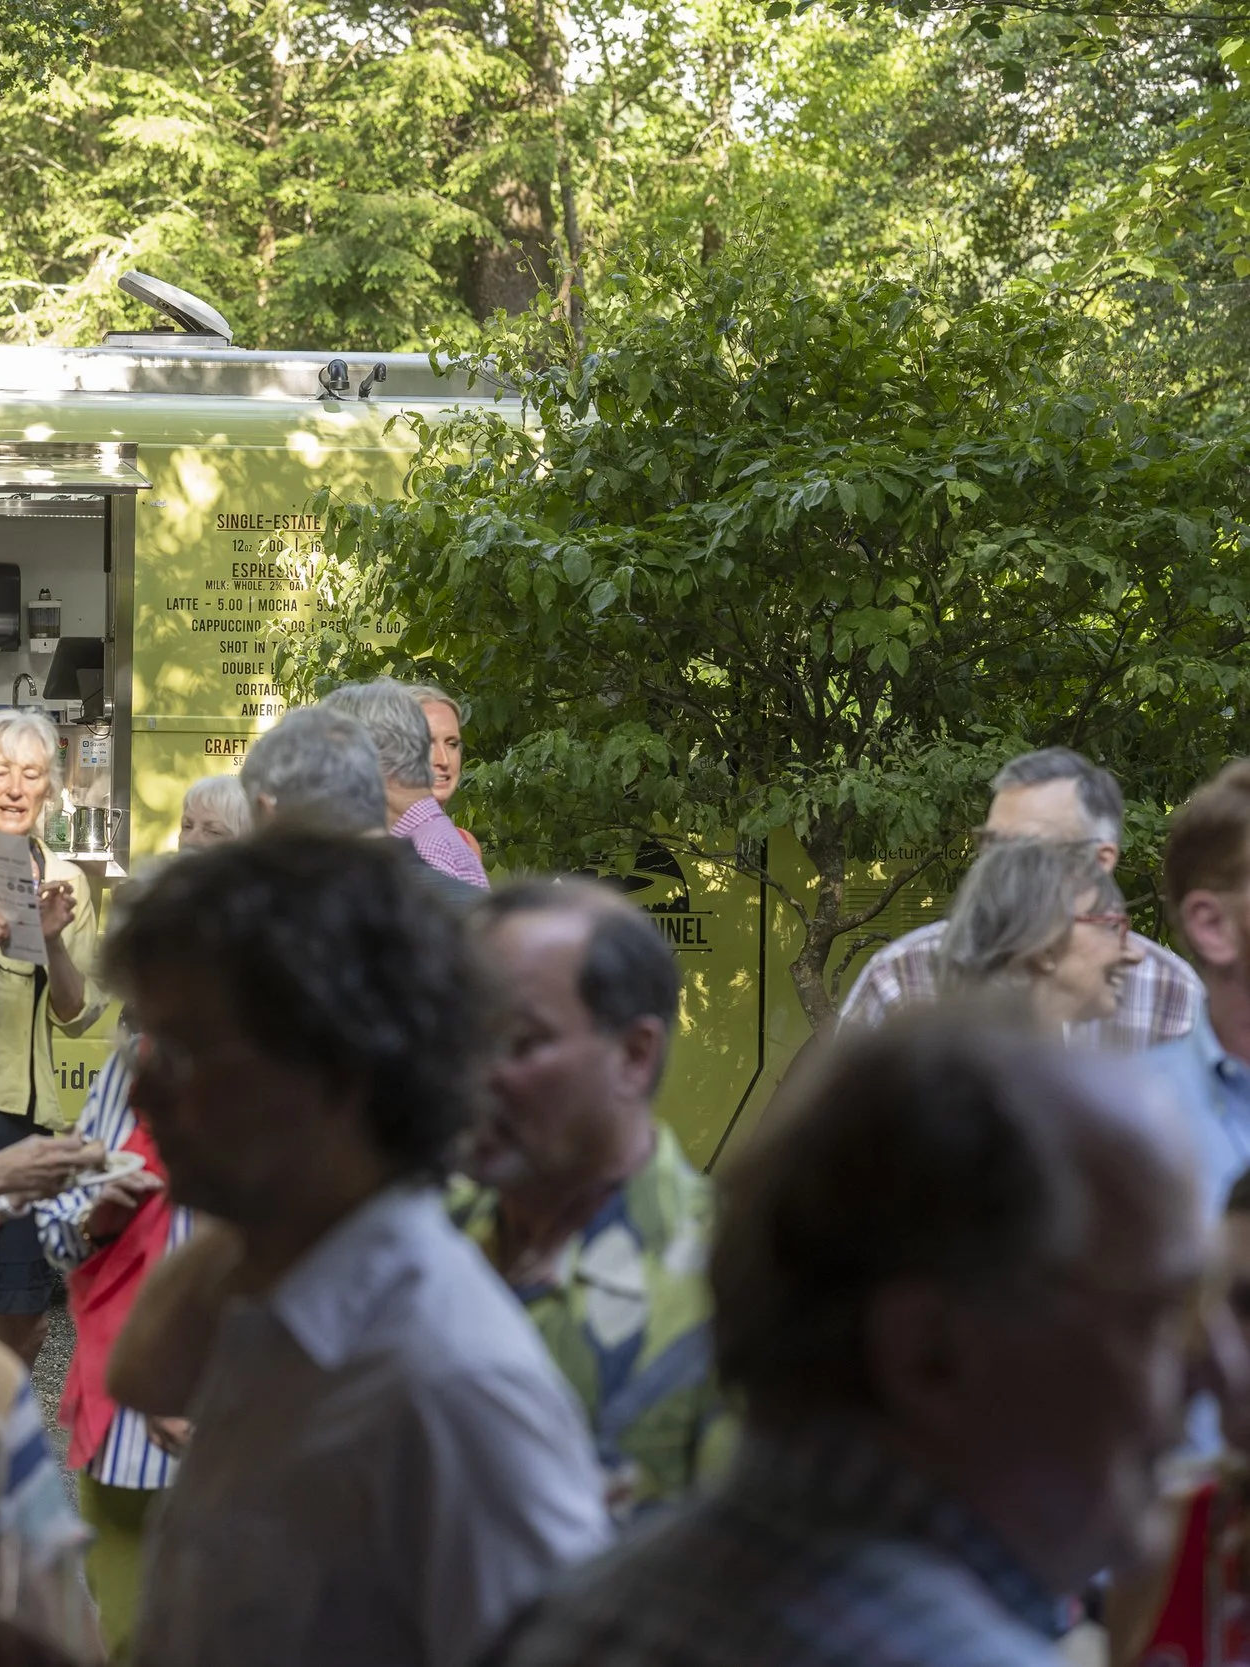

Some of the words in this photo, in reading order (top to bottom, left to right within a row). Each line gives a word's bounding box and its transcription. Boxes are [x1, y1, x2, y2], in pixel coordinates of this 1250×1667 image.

[217, 514, 321, 530] SINGLE-ESTATE
[205, 580, 229, 590] MILK:
[166, 597, 199, 610] LATTE
[217, 598, 243, 611] 5.00
[258, 599, 298, 611] MOCHA
[191, 619, 261, 632] CAPPUCCINO
[375, 621, 401, 634] 6.00
[220, 641, 248, 653] SHOT
[254, 641, 265, 653] IN
[222, 662, 265, 675] DOUBLE
[235, 683, 285, 696] CORTADO
[241, 703, 287, 716] AMERIC
[205, 739, 248, 754] CRAFT
[650, 917, 708, 944] NNEL
